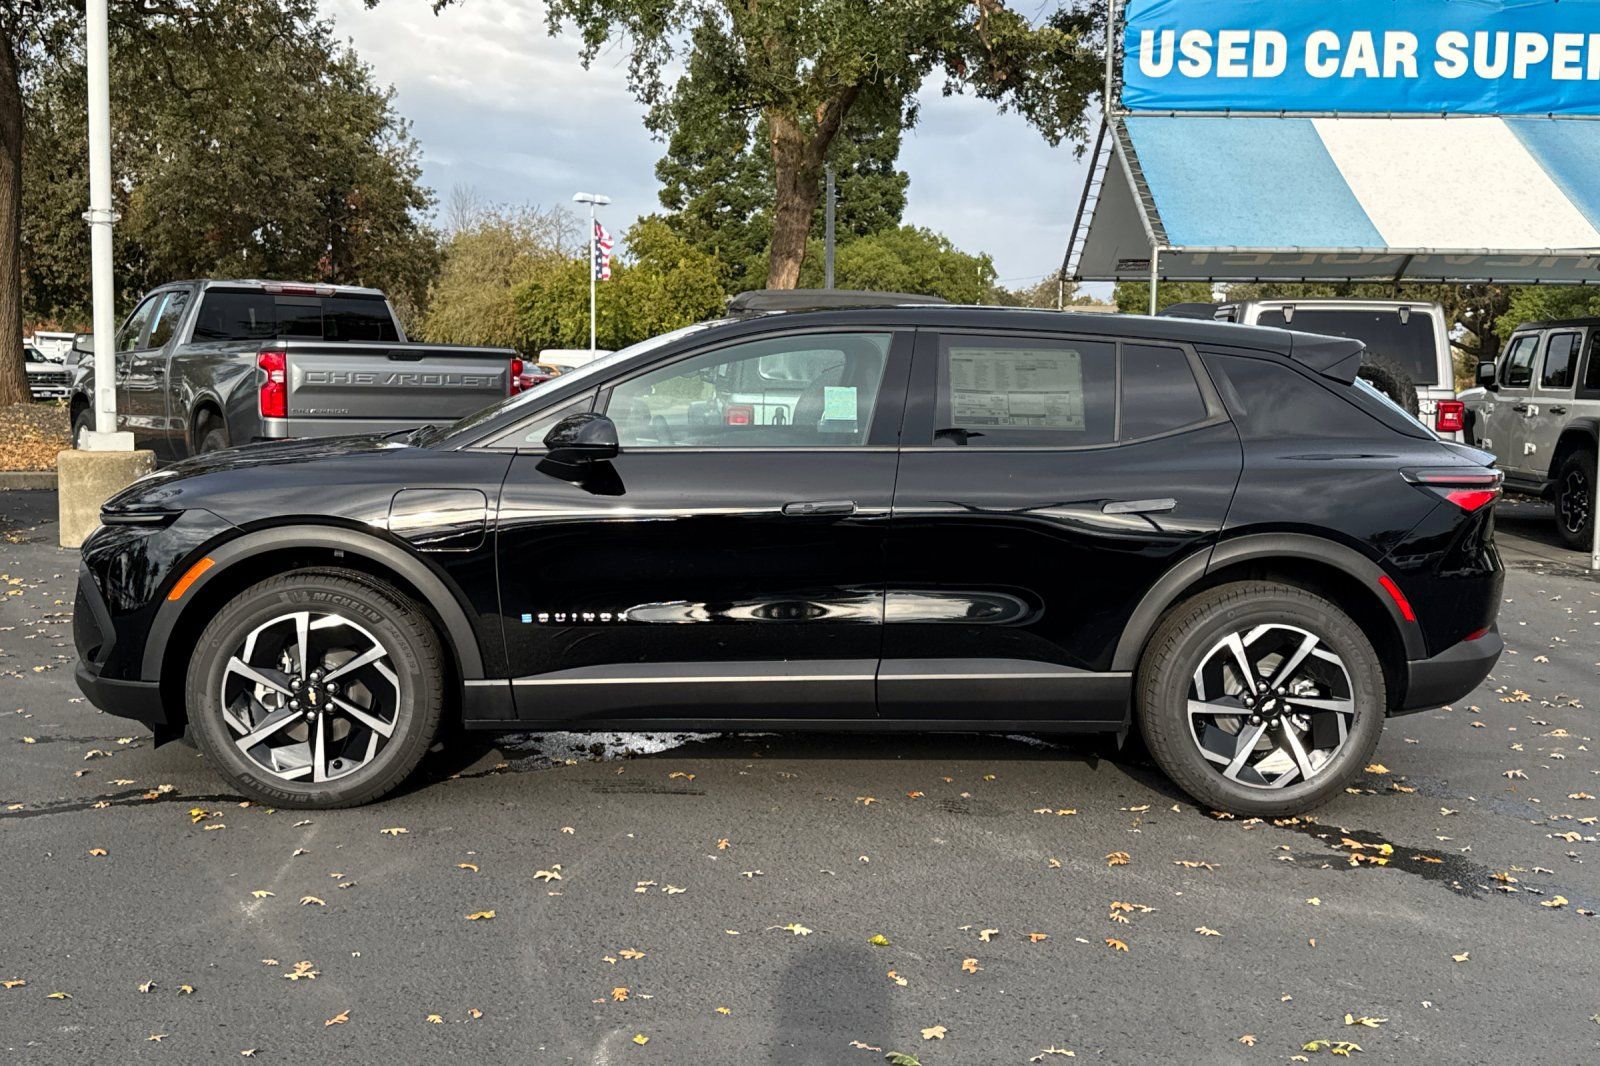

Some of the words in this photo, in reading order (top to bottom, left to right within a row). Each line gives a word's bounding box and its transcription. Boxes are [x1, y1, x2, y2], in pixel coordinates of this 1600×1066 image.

[1139, 29, 1288, 78] USED
[1304, 30, 1419, 79] CAR
[1433, 31, 1600, 80] SUPE
[304, 371, 498, 387] CHEVROLET
[313, 592, 380, 621] MICHELIN
